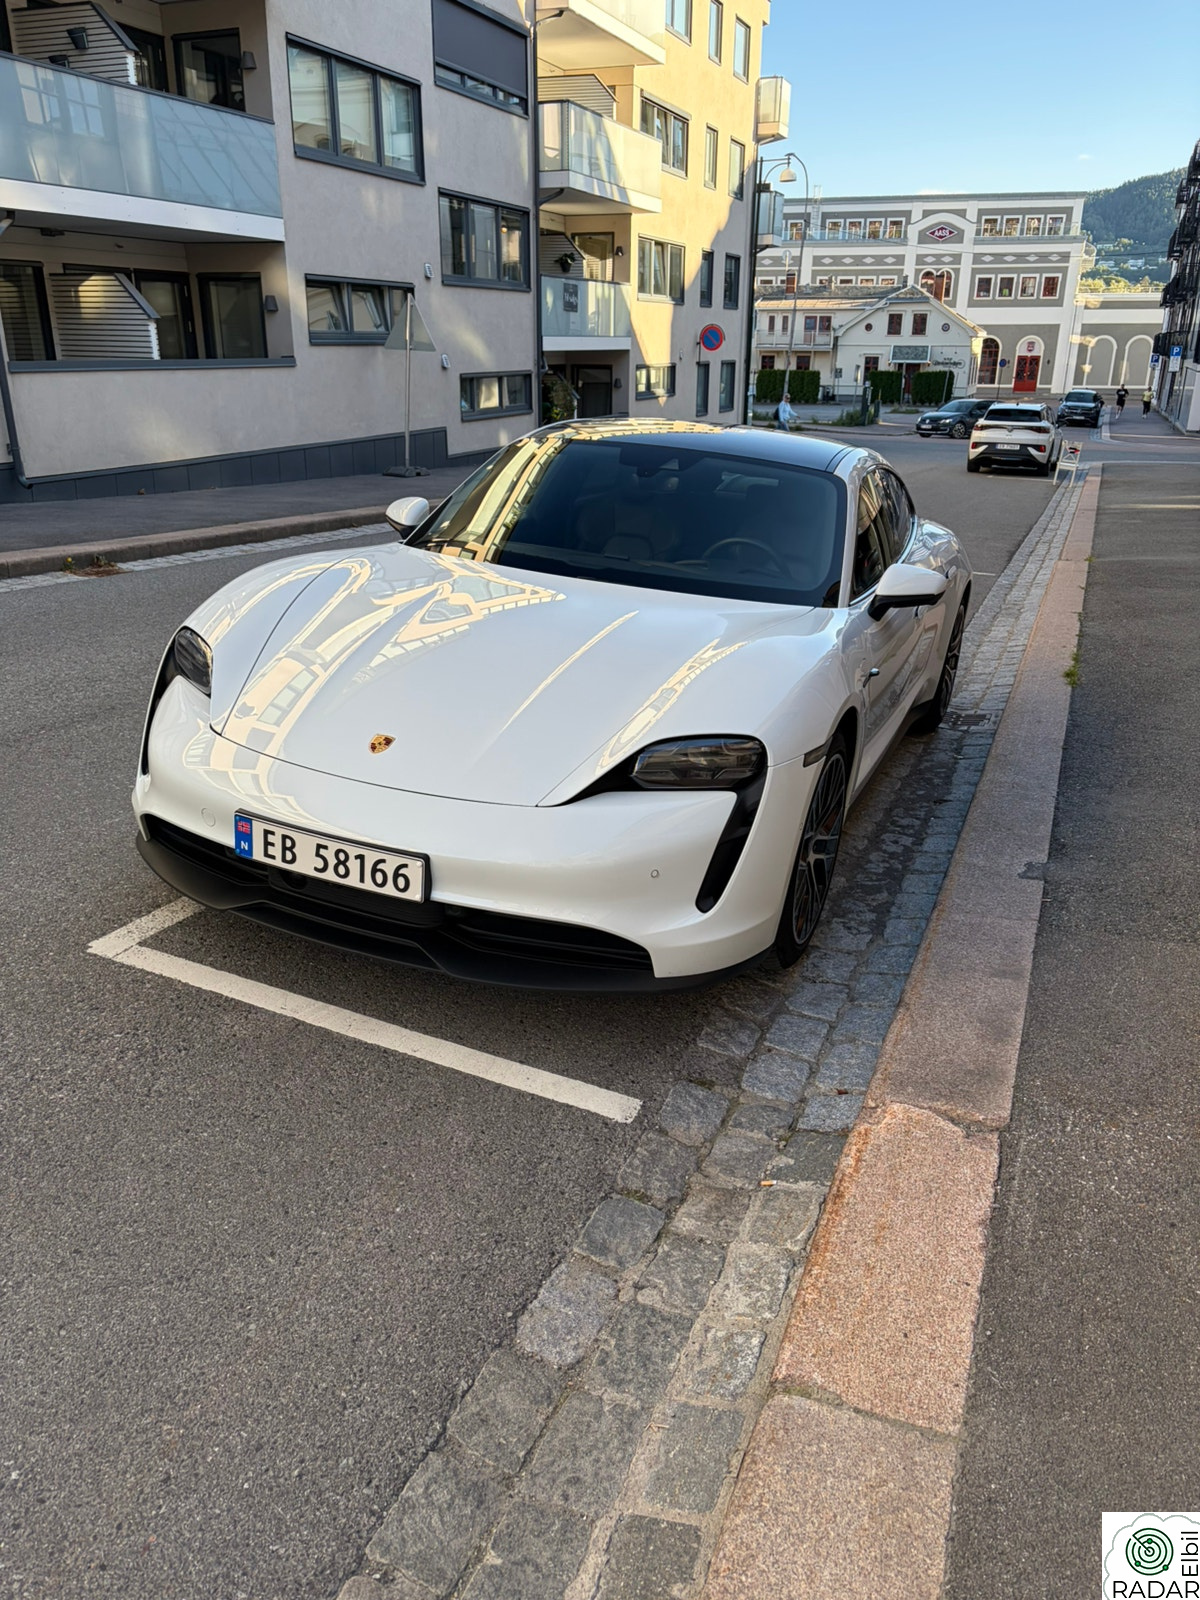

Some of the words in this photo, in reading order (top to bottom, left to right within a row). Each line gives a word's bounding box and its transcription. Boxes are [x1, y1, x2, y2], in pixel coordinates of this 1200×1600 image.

[1173, 347, 1180, 356] P
[240, 841, 249, 851] N
[263, 828, 297, 865] EB
[313, 843, 411, 894] 58166
